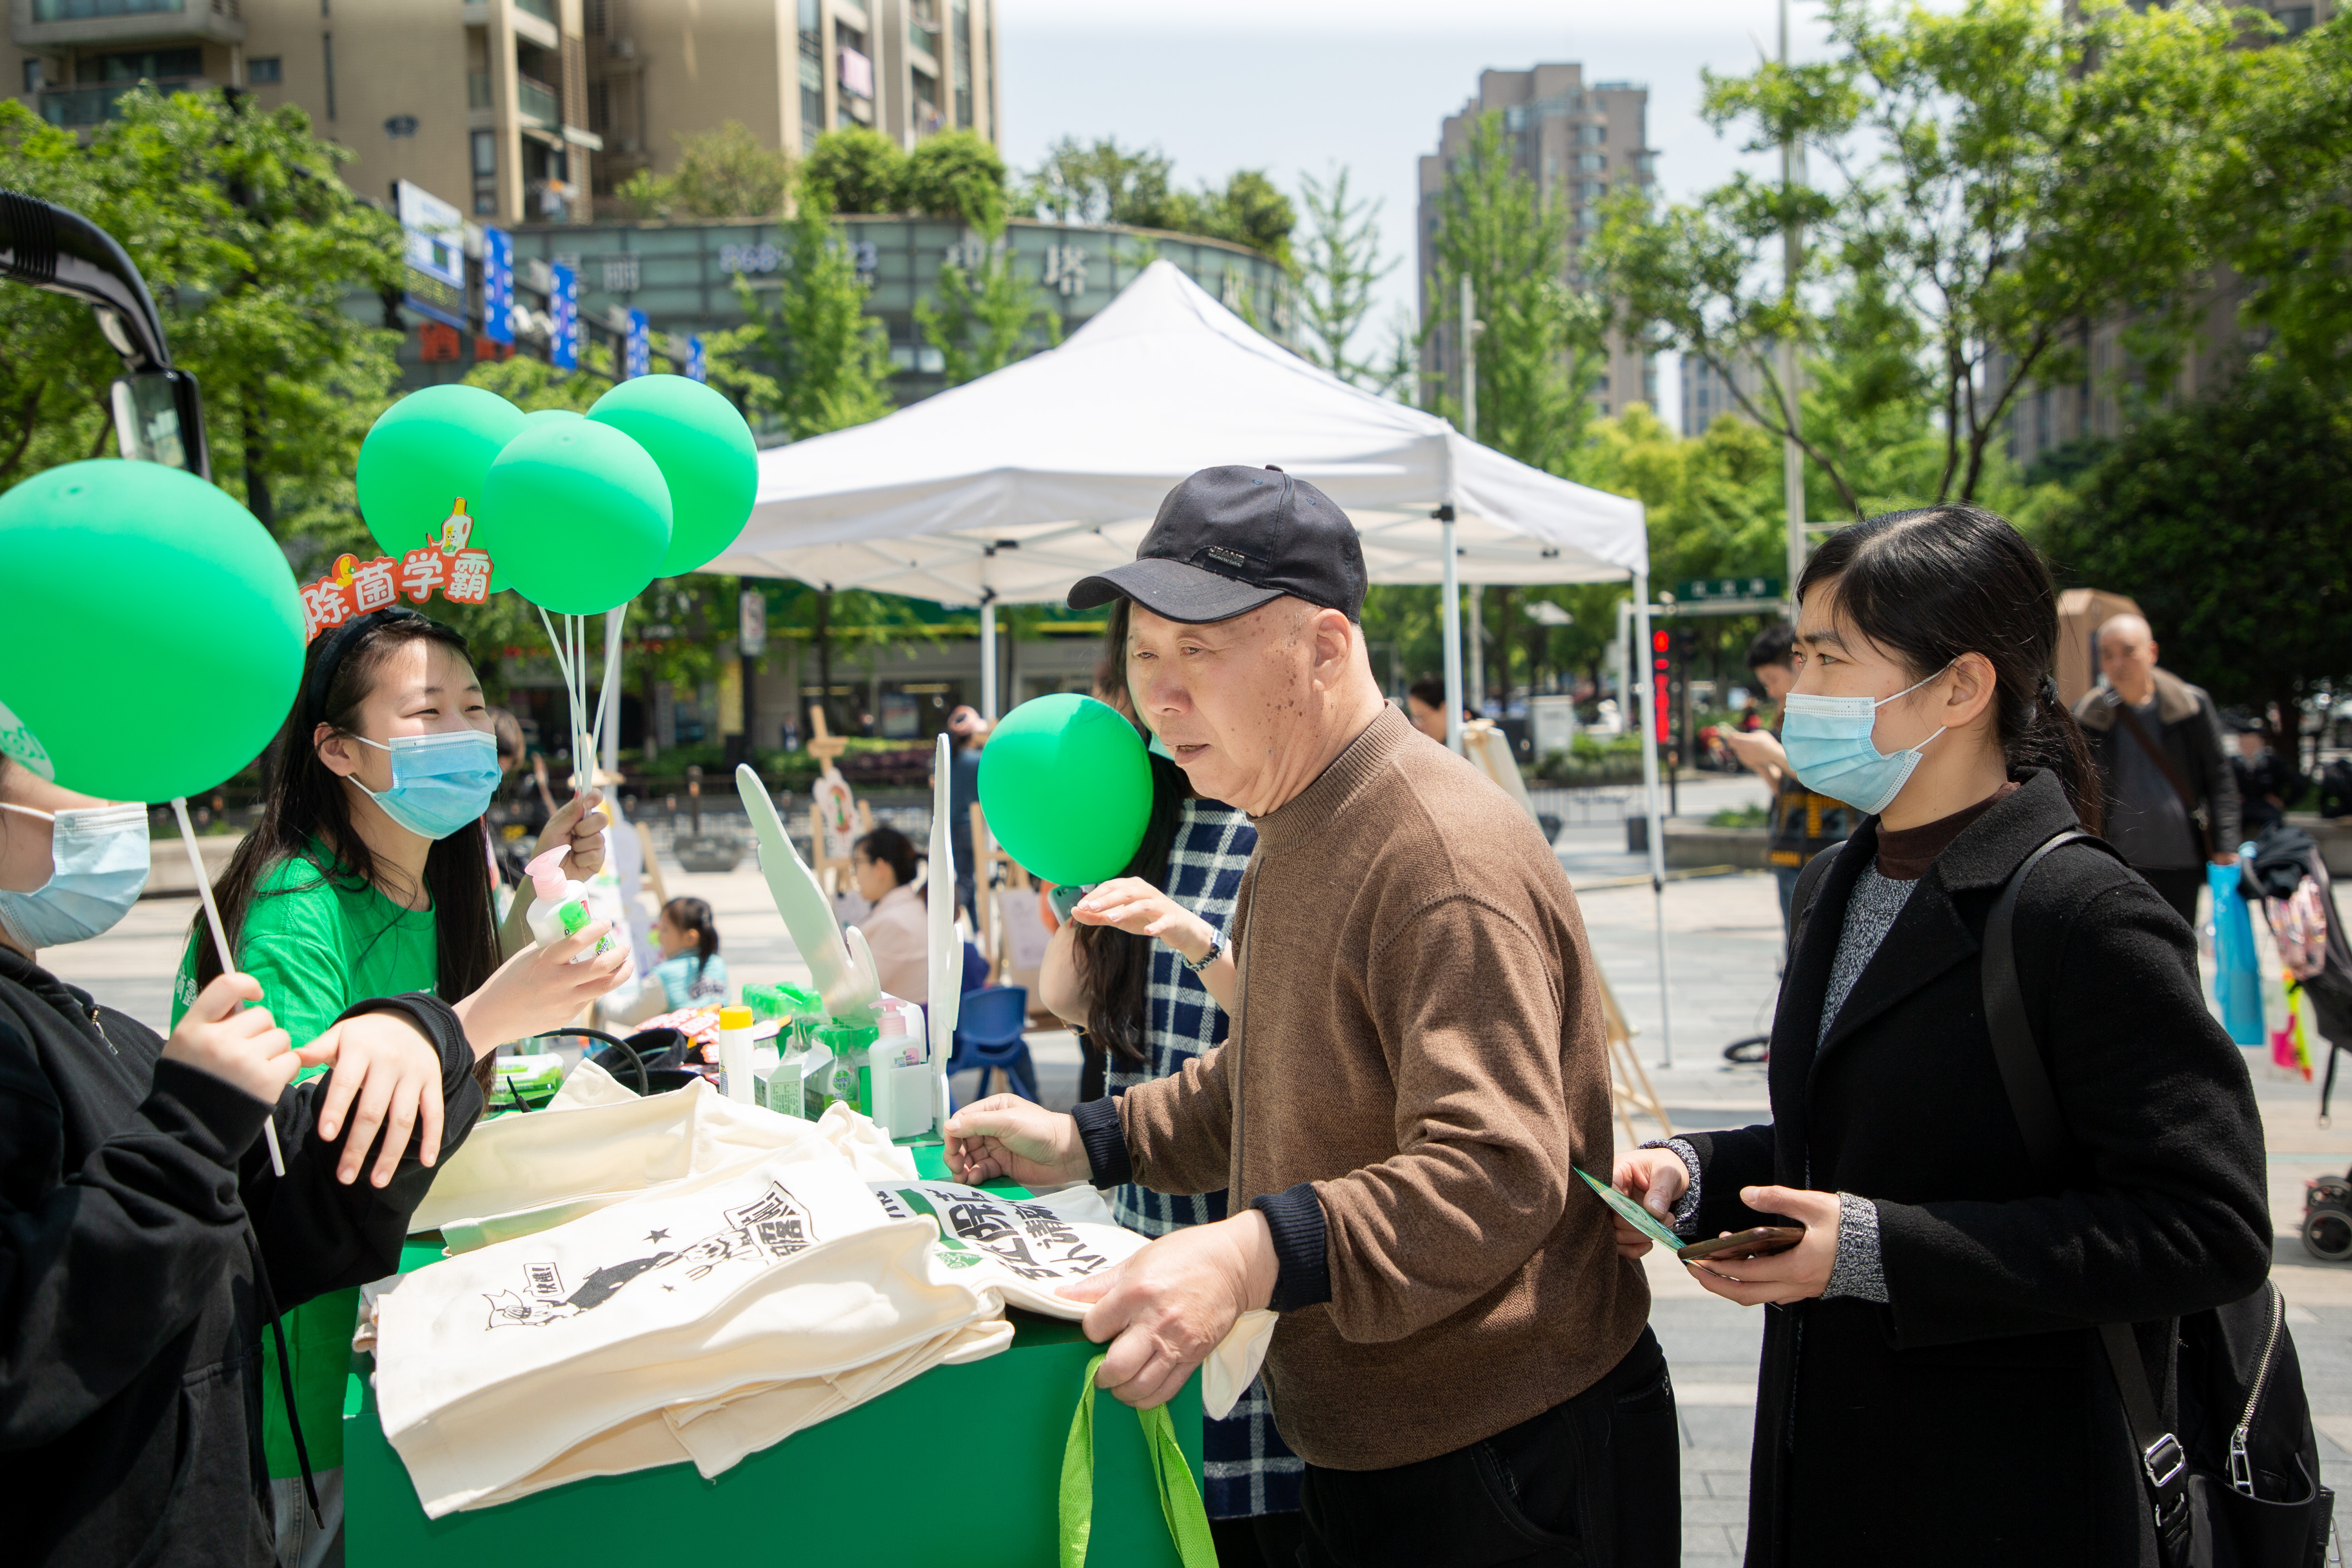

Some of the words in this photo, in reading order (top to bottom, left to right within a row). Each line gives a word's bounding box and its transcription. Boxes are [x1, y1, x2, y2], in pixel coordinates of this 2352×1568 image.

[1209, 546, 1245, 563] JEANS
[302, 552, 490, 641] 除菌学霸
[597, 938, 609, 956] Dettol
